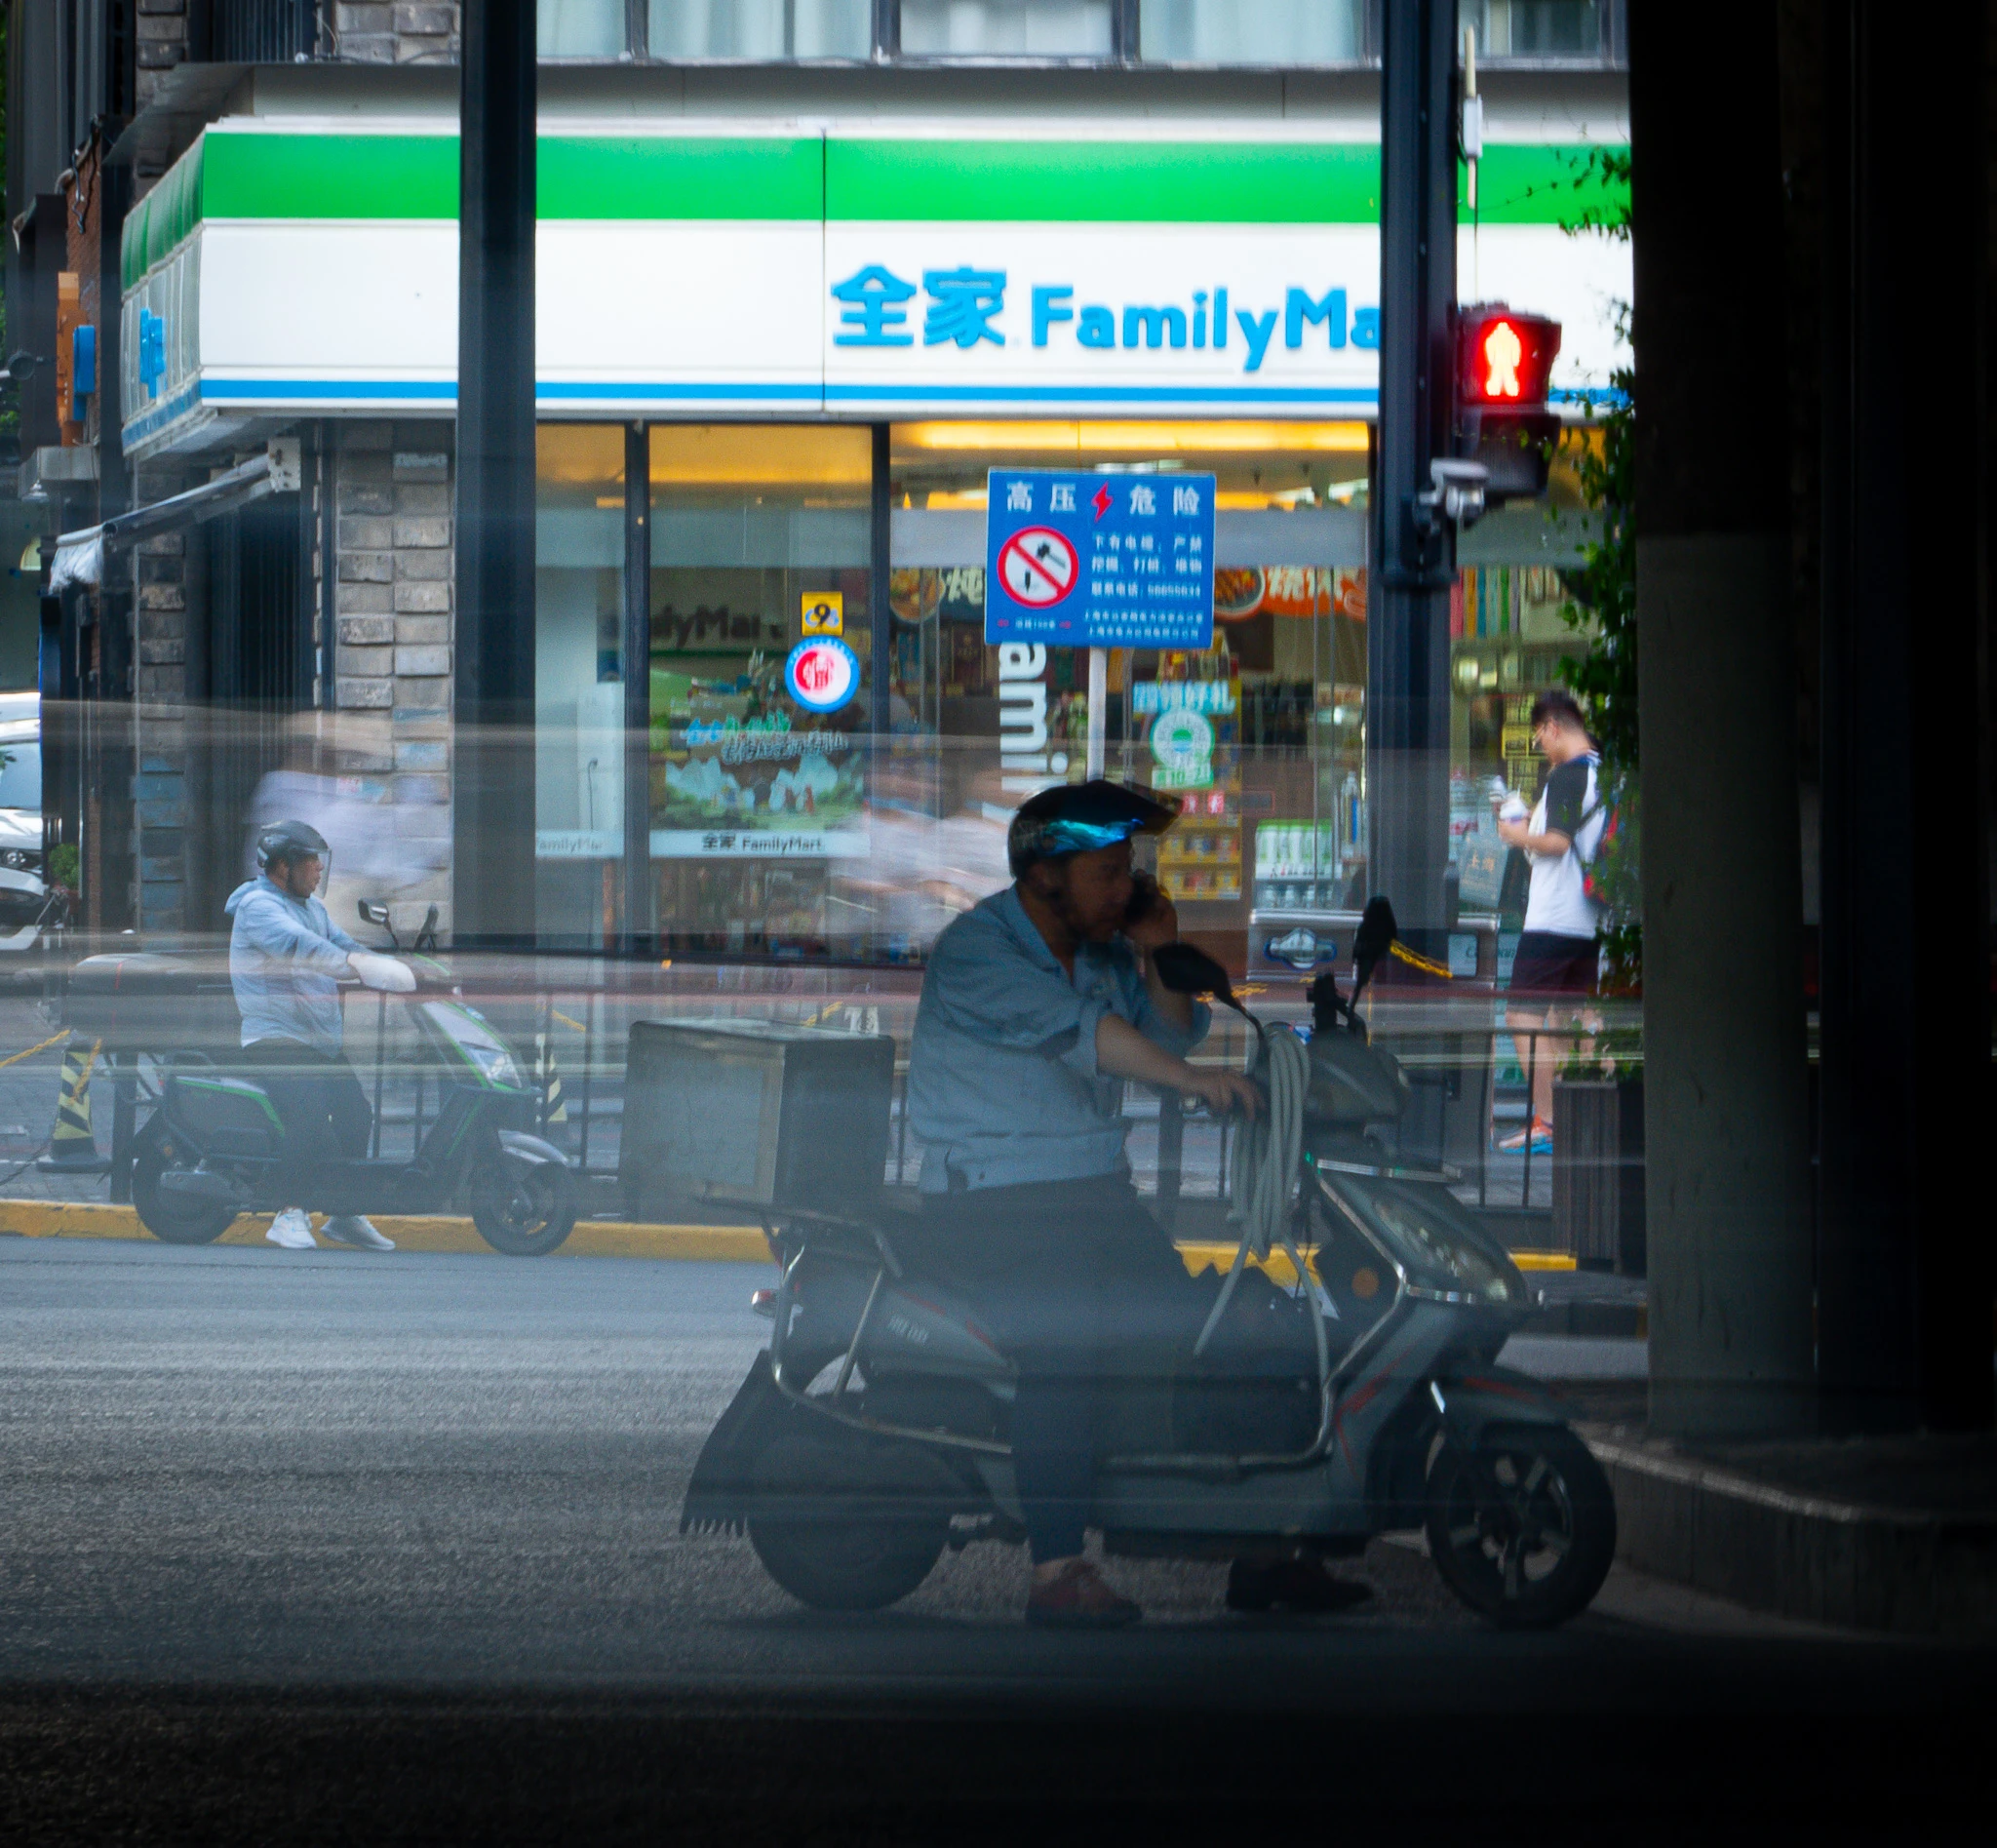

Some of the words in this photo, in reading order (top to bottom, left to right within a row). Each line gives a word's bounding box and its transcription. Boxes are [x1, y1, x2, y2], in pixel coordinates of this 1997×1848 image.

[831, 264, 1007, 348] 全家
[1031, 285, 1380, 373] FamilyMa
[1006, 480, 1077, 513] 高压
[1129, 484, 1201, 516] 危险
[998, 641, 1069, 795] amil
[742, 837, 823, 856] FamilyMart
